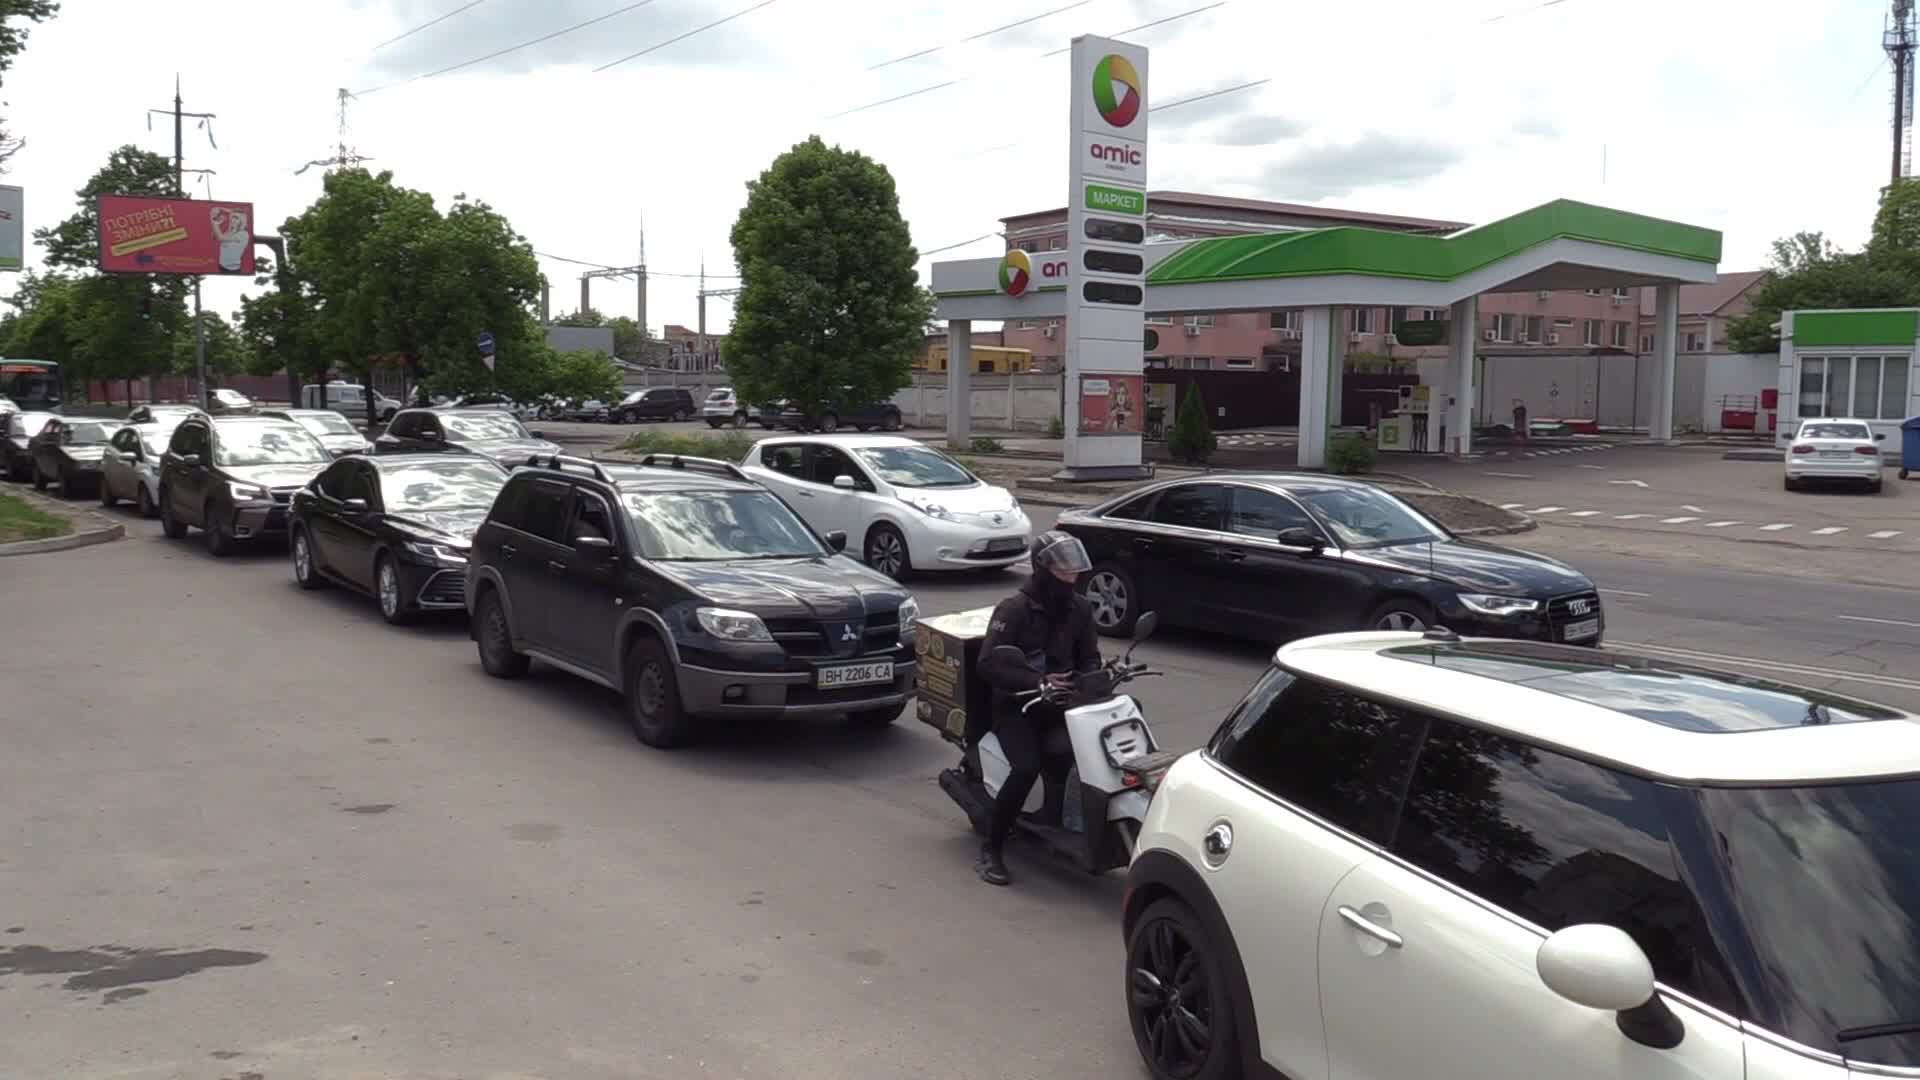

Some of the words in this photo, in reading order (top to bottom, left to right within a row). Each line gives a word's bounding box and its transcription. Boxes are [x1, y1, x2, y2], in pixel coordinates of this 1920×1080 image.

[1090, 144, 1141, 165] amic
[1093, 192, 1137, 208] МАРКЕТ
[825, 669, 842, 683] BH
[845, 667, 871, 681] 2206
[875, 664, 891, 679] CA
